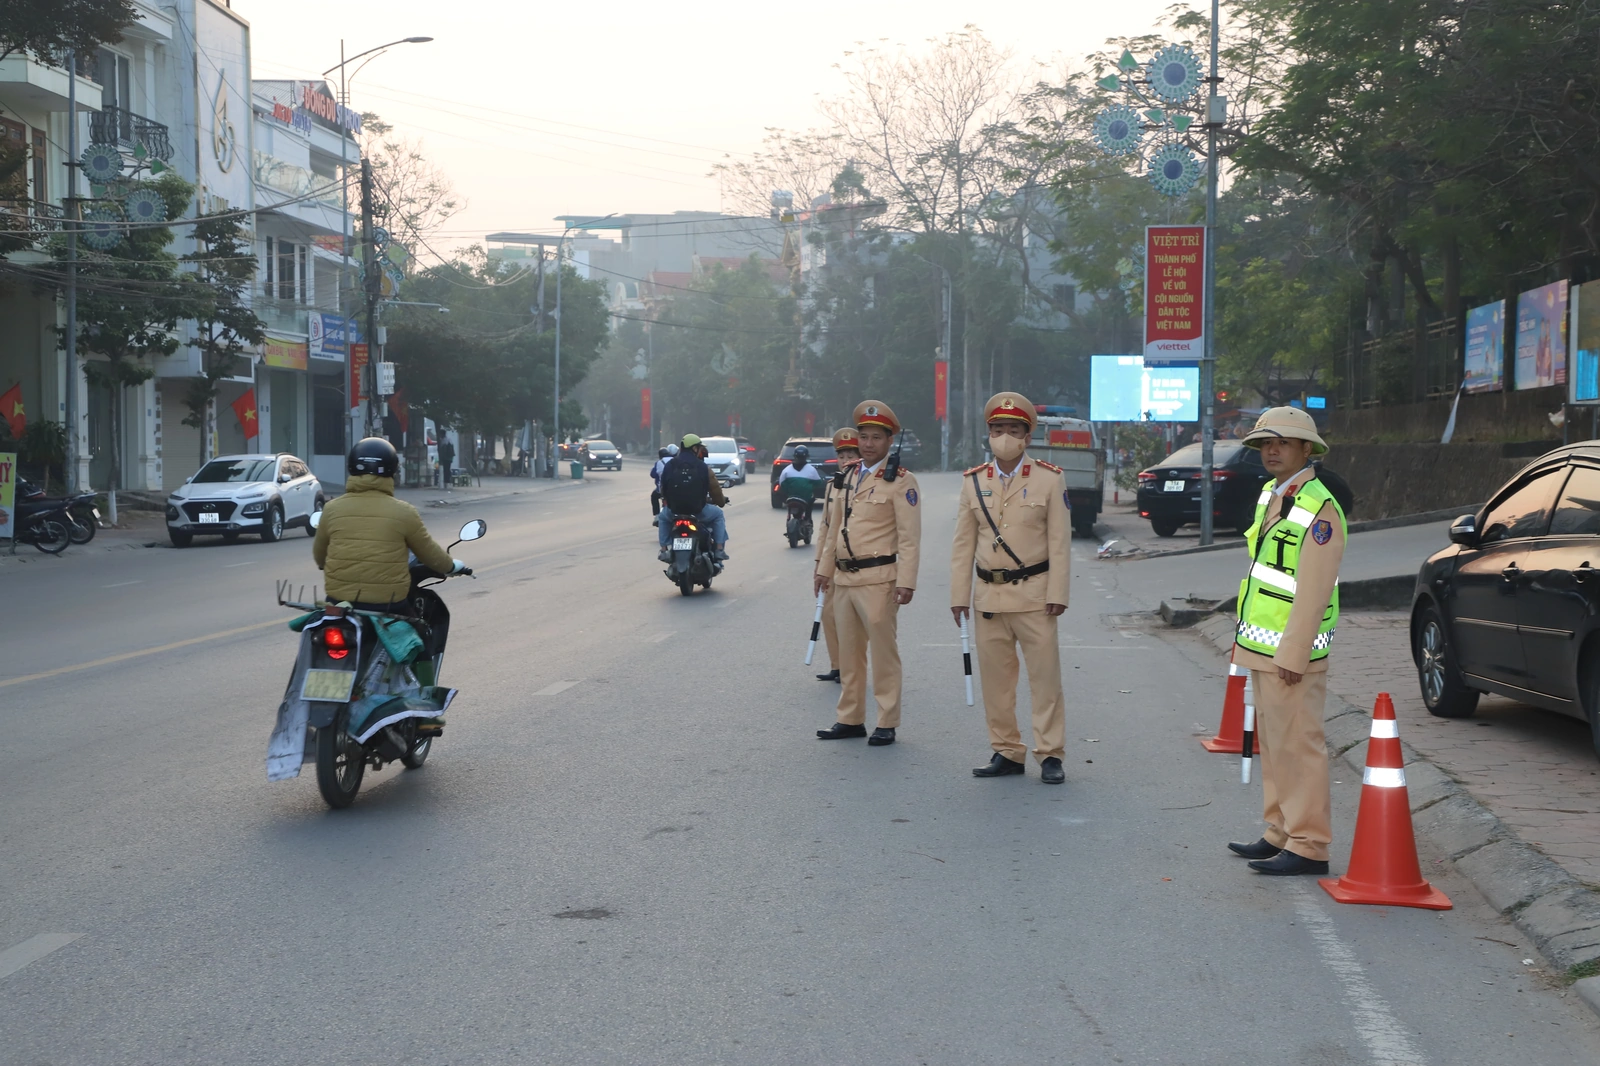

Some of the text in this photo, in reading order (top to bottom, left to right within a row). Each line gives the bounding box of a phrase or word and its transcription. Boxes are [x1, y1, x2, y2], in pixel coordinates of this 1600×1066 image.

[1152, 232, 1200, 249] VIỆT TRÌ
[1154, 252, 1197, 264] THÀNH PHỐ
[1163, 265, 1187, 278] LỄ HỘI
[1174, 280, 1187, 290] VỚI
[1155, 292, 1167, 305] CỘI
[1158, 306, 1190, 318] DÂN TỘC
[1156, 319, 1191, 331] VIỆT NAM
[1156, 343, 1191, 351] viettel
